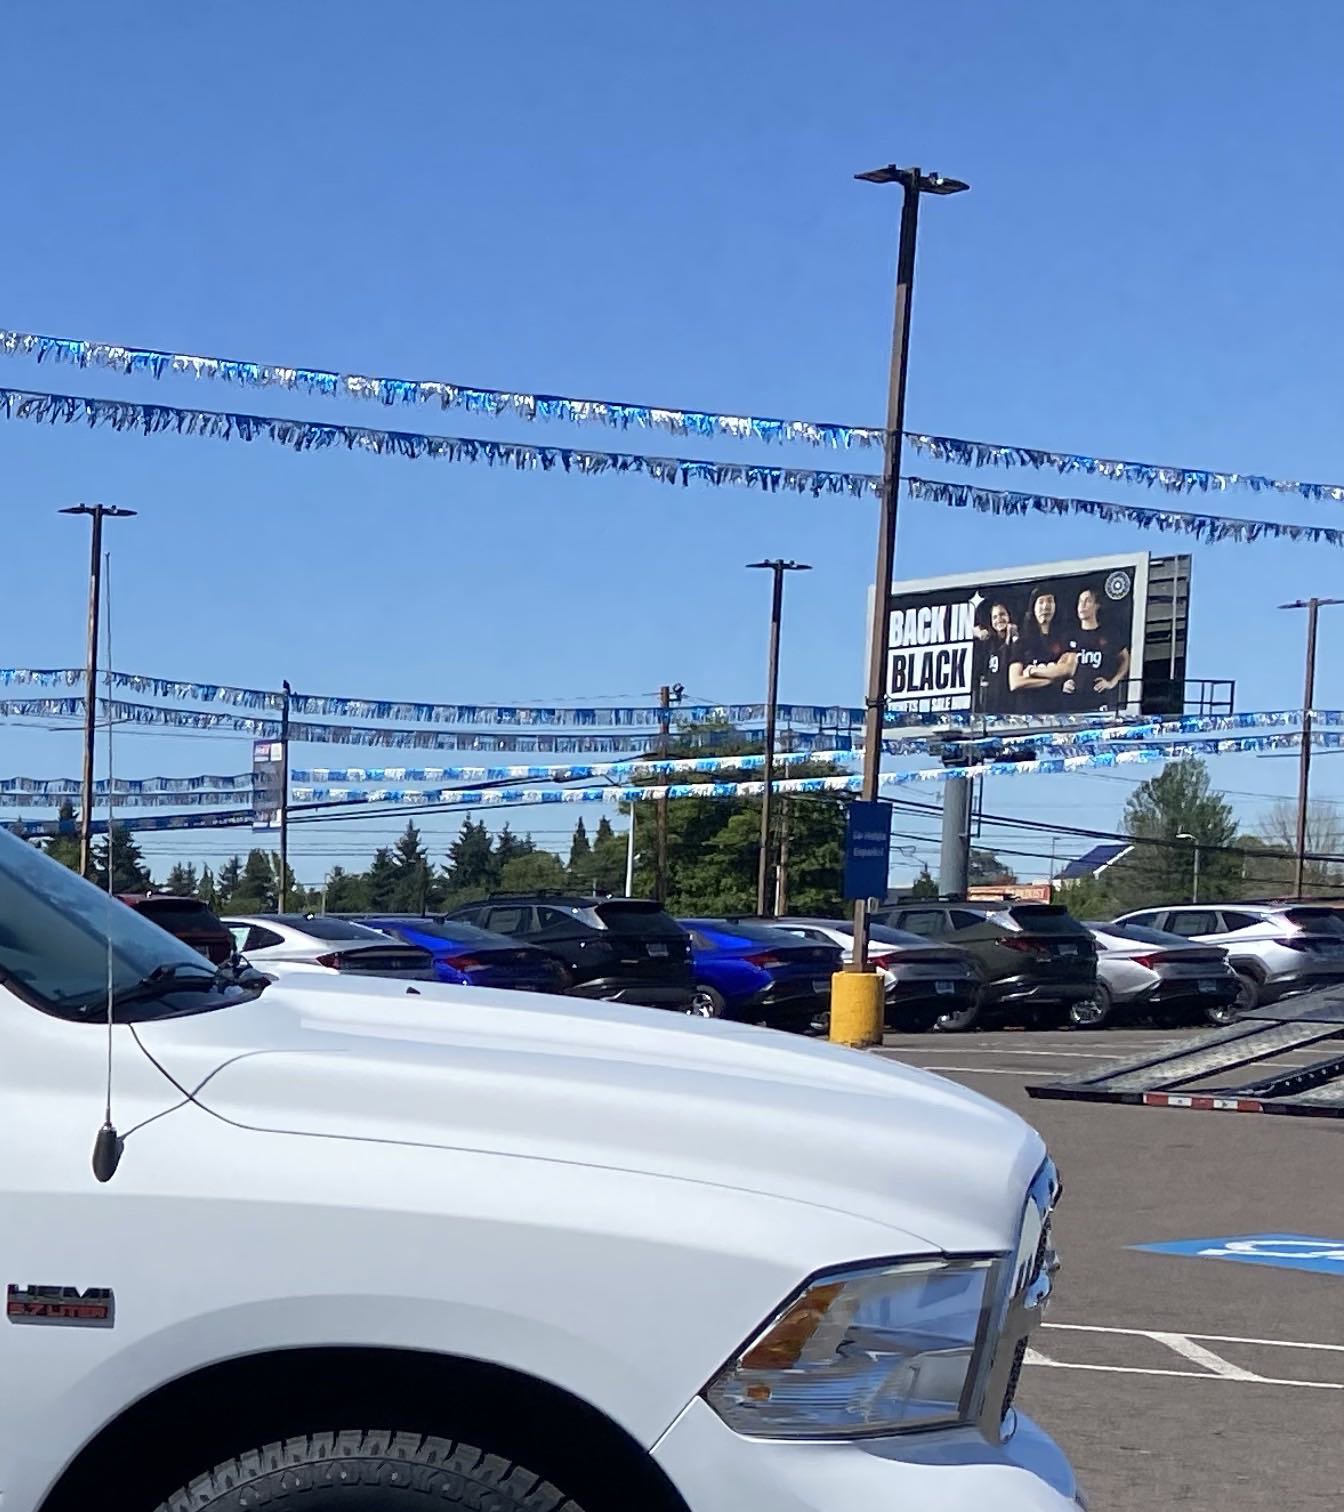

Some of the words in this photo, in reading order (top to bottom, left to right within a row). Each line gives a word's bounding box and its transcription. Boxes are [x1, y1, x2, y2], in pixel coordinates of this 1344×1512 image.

[889, 605, 946, 647] BACK
[950, 602, 974, 641] IN
[891, 648, 968, 694] BLACK
